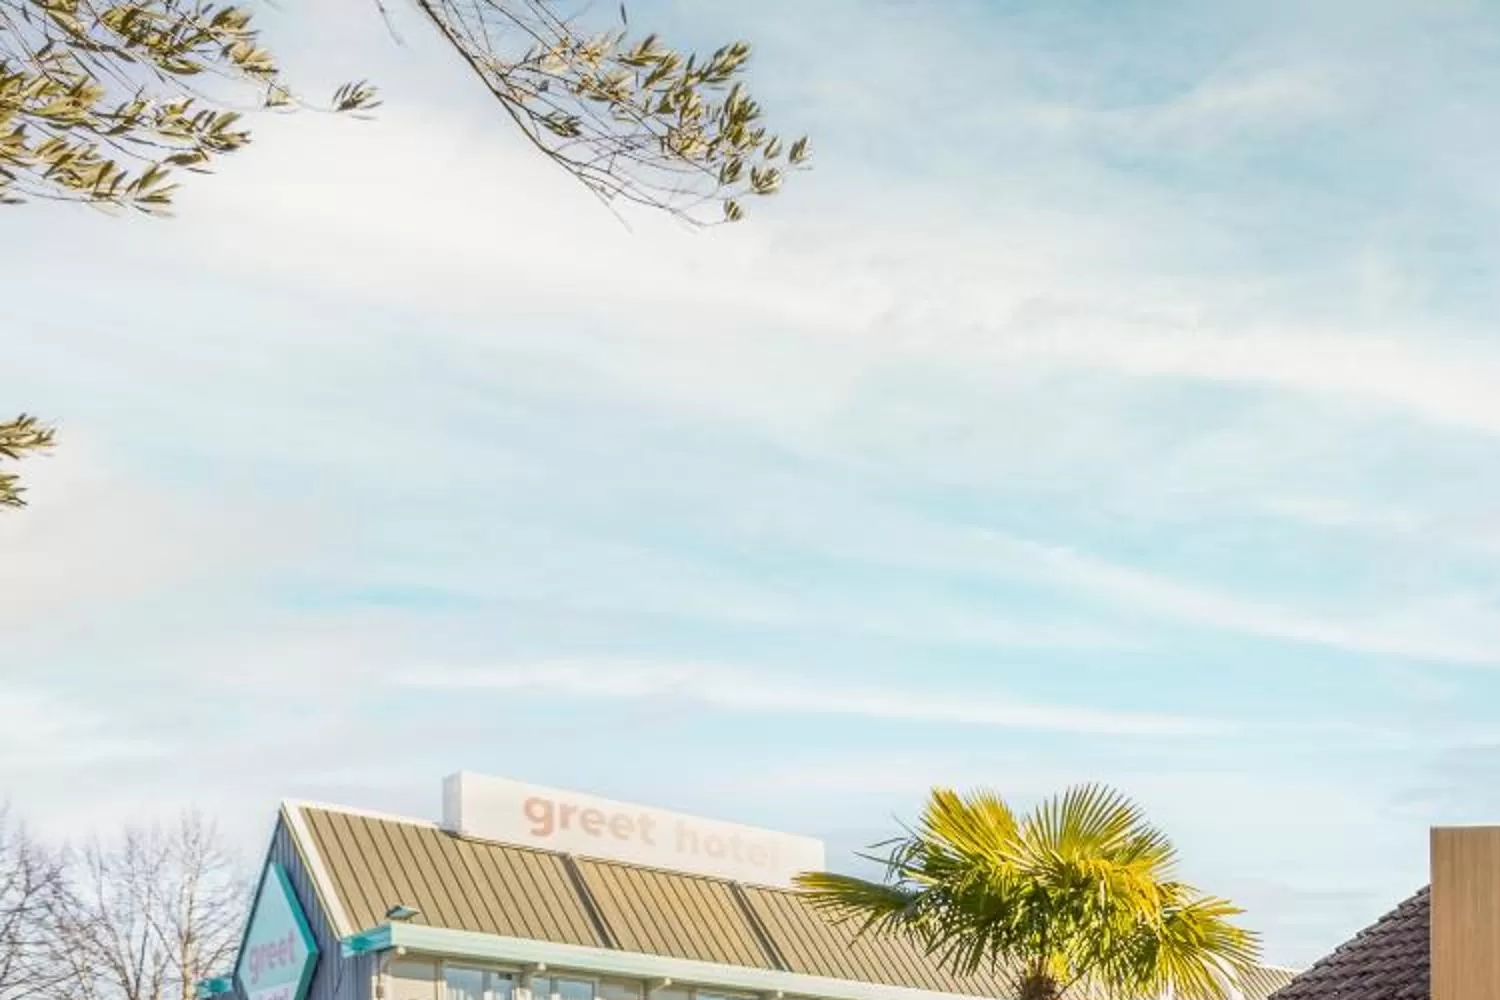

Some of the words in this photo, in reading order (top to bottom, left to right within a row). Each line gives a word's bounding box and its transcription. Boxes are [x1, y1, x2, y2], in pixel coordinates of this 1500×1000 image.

[522, 795, 658, 846] greet
[674, 818, 782, 870] hotel
[248, 926, 298, 985] greet
